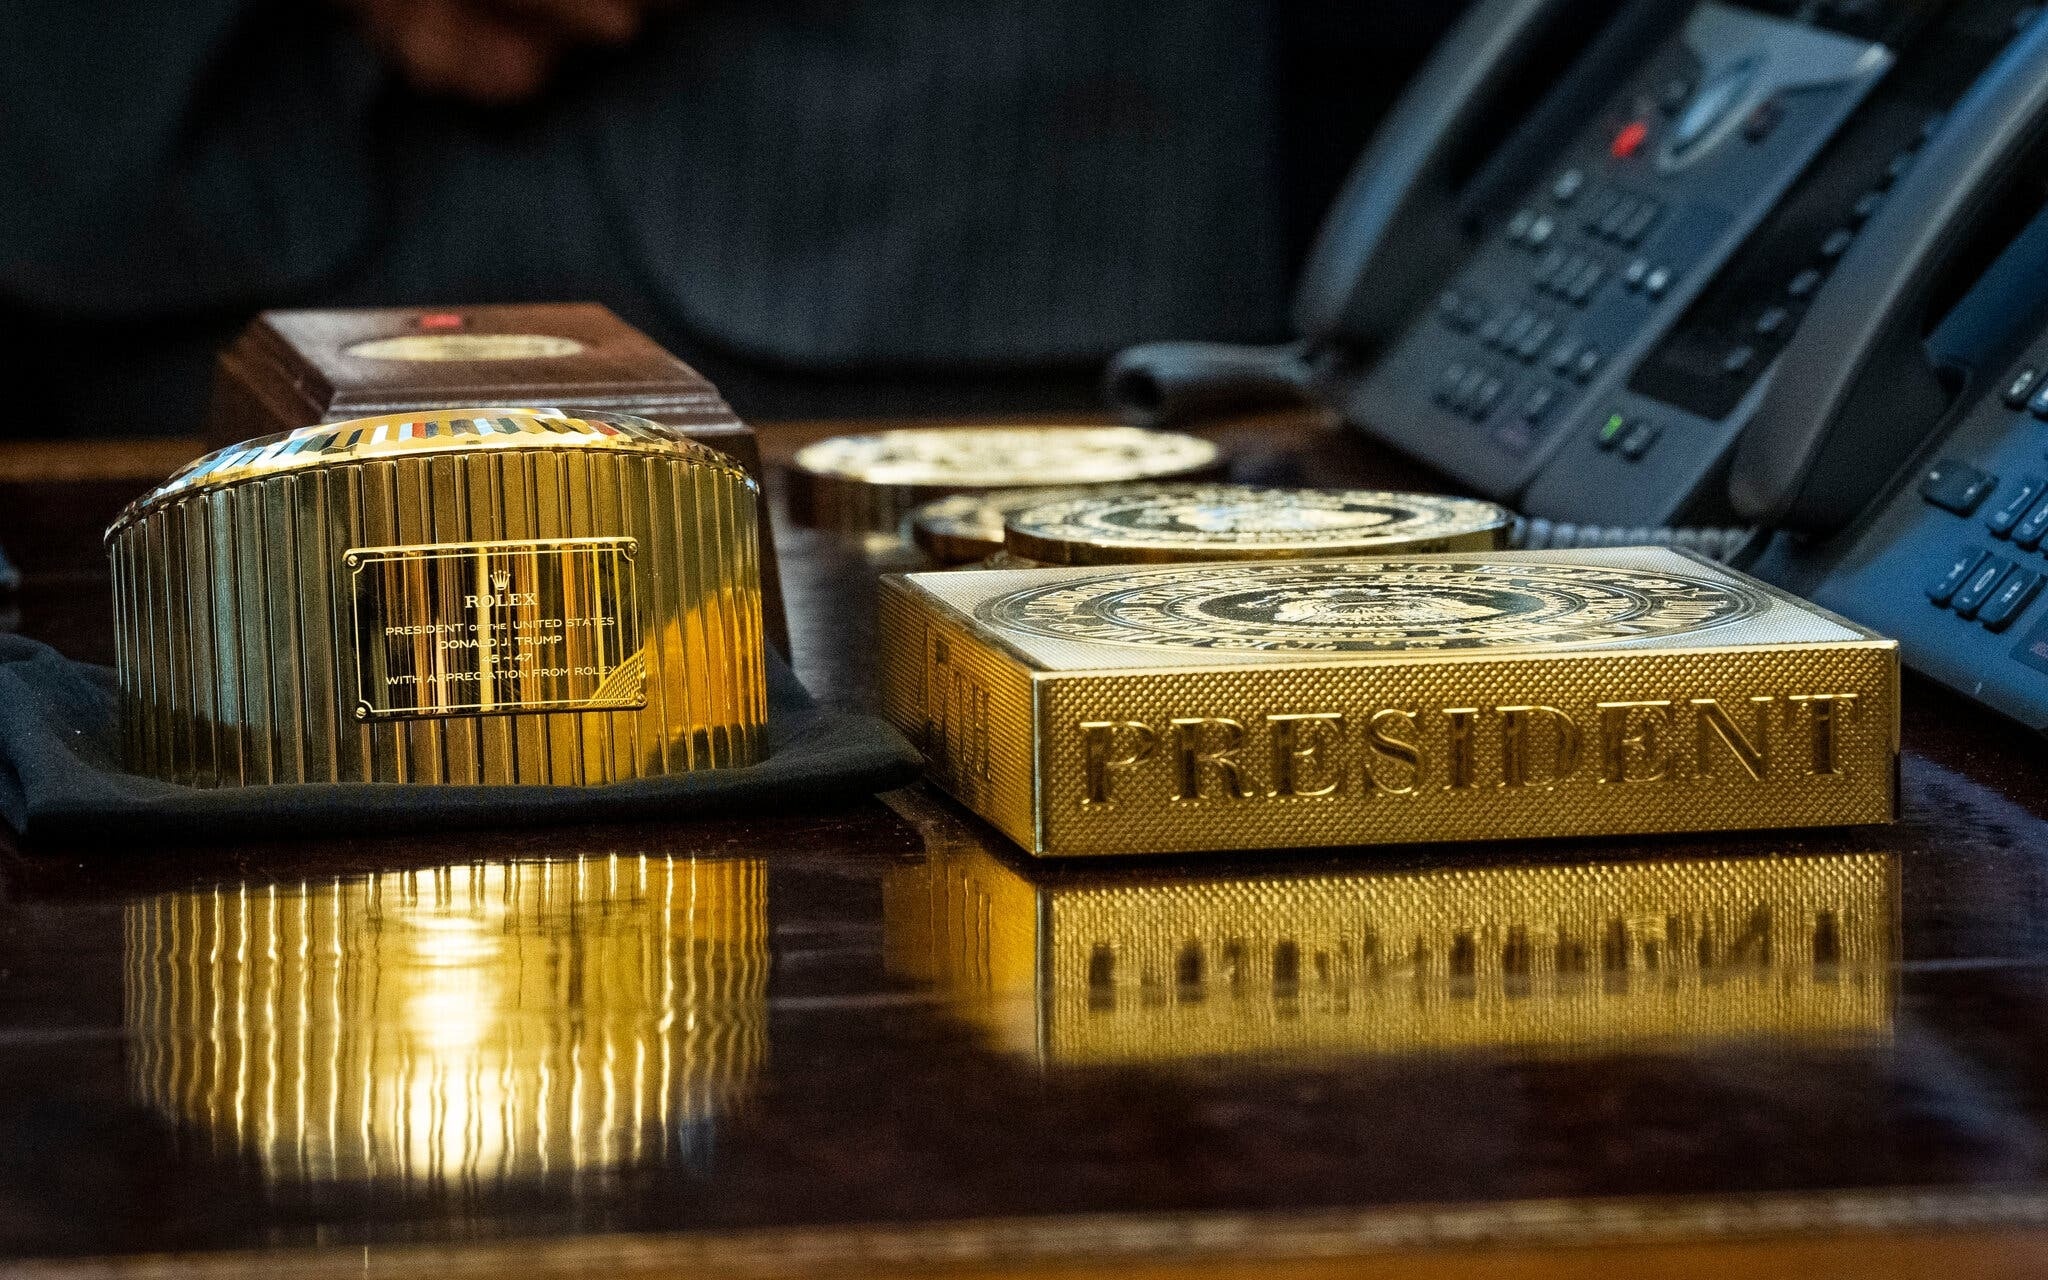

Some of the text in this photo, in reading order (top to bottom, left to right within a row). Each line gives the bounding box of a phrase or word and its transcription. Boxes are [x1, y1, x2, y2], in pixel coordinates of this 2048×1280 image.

[464, 592, 538, 609] ROLEX
[385, 623, 465, 636] PRESIDENT
[513, 619, 563, 630] UNITED
[566, 617, 615, 627] STATES
[500, 637, 511, 647] J.
[514, 635, 563, 646] TRUMP
[480, 654, 500, 664] 45
[514, 653, 533, 662] 47
[385, 665, 617, 685] WITH APPRECATION FROM ROLEX
[1079, 692, 1861, 808] PRESIDENT
